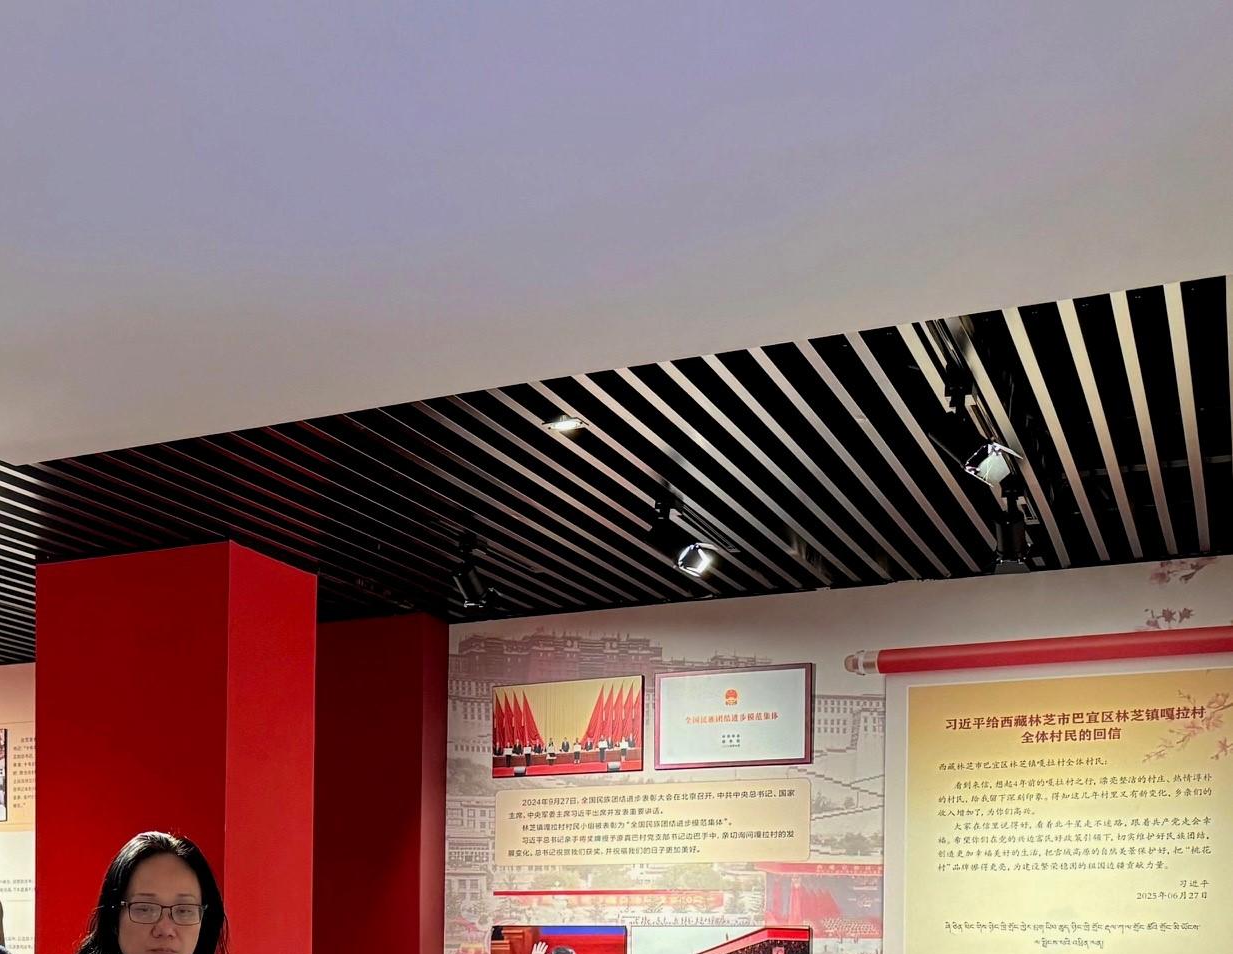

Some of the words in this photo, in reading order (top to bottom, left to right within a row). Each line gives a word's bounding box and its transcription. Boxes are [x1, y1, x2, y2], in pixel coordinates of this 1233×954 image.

[945, 706, 1206, 730] 习近平给西藏林芝市巴宜区林芝镇嘎拉村
[1021, 727, 1121, 744] 全体村民的回信
[1178, 878, 1210, 889] 习近平
[1136, 890, 1208, 901] 2025年06月27日
